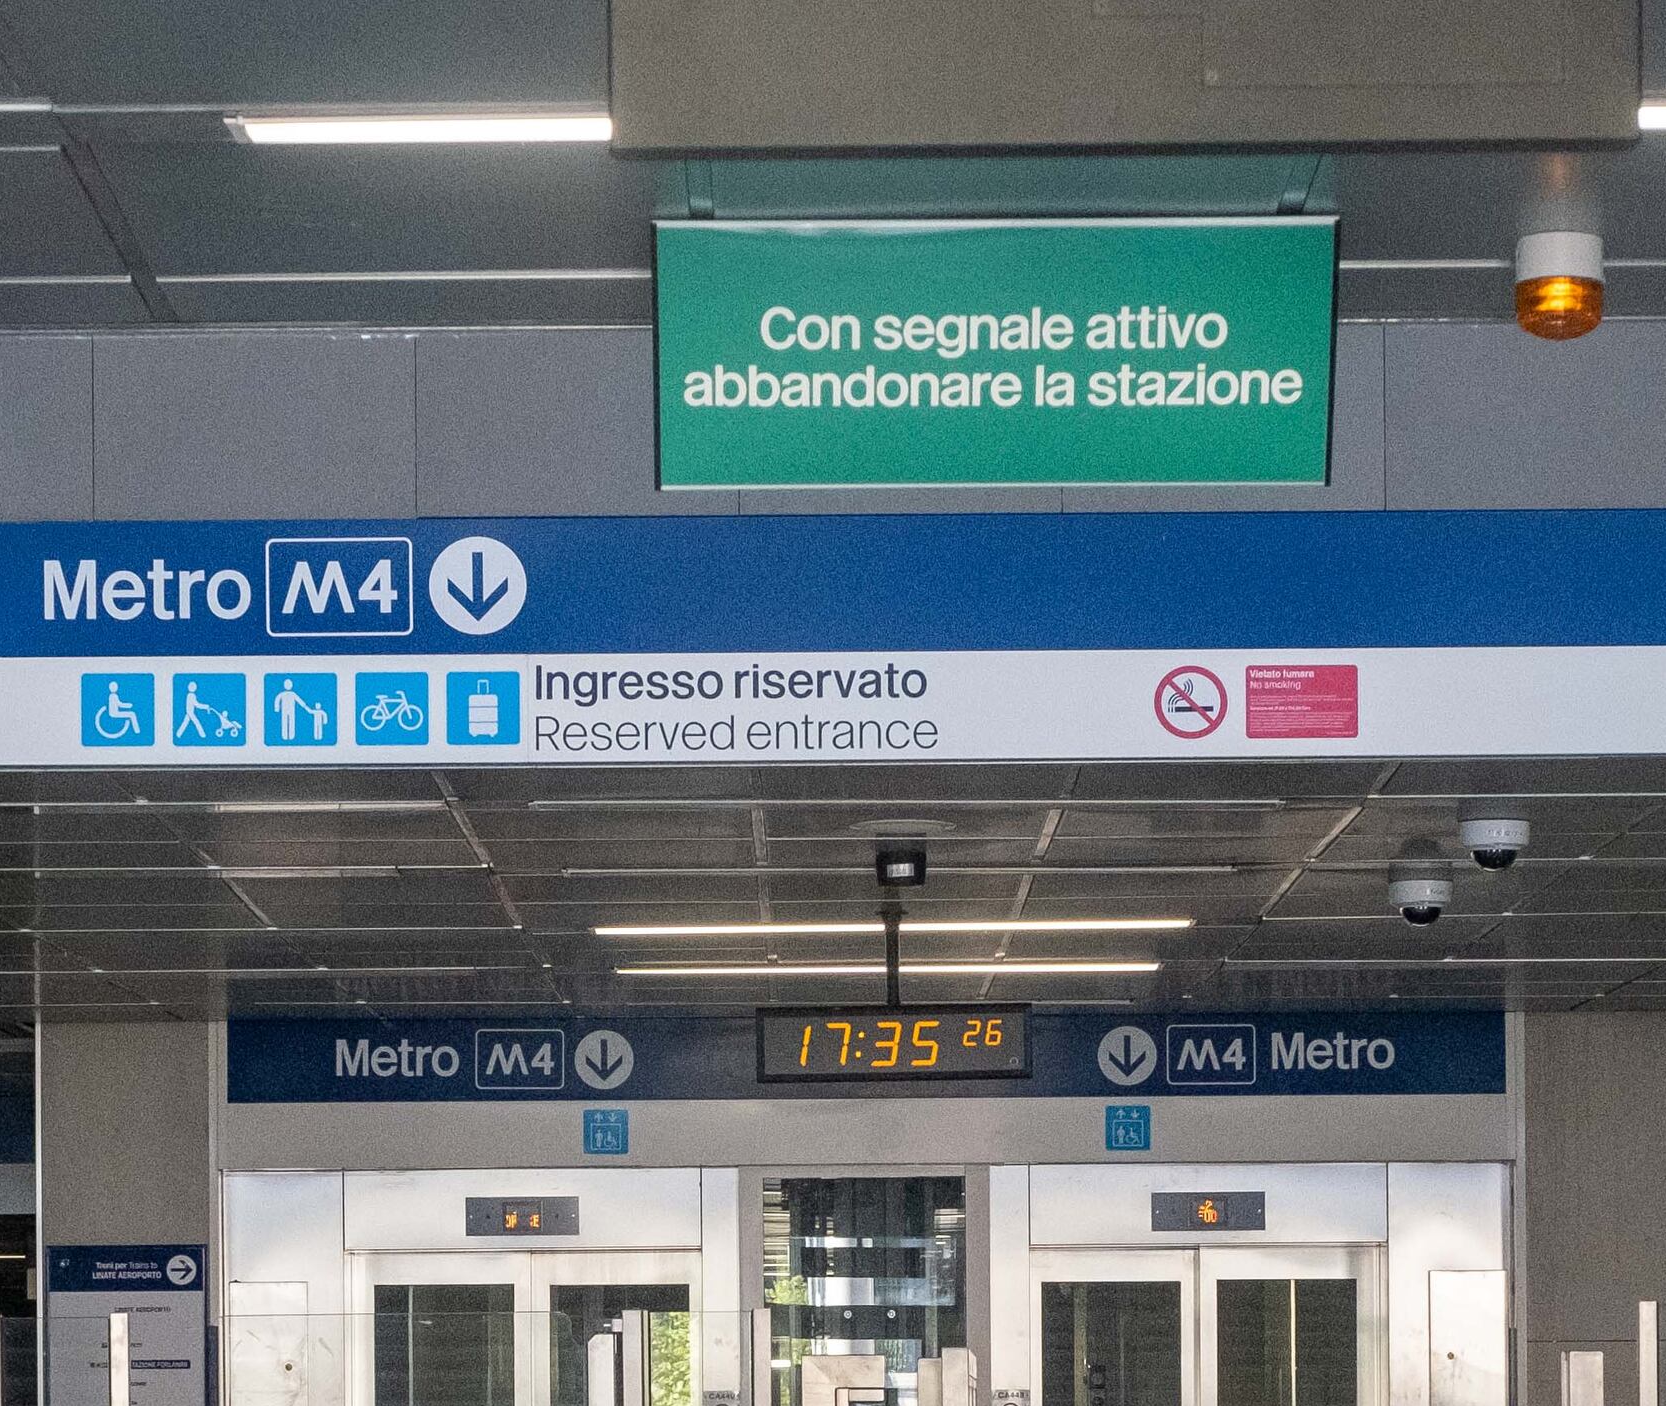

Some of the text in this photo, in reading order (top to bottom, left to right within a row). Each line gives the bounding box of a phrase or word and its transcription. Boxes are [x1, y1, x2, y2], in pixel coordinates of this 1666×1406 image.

[760, 305, 1229, 360] Con segnale attivo
[683, 362, 1303, 408] abbandonare la stazione
[43, 558, 398, 621] Metro M4
[535, 662, 928, 708] Ingresso riservato
[1249, 669, 1315, 679] Vietato fumare
[1249, 680, 1301, 691] No smoking
[535, 714, 939, 752] Reserved entrance
[335, 1038, 555, 1078] Metro M4
[798, 1019, 1003, 1068] 17:35 26
[1176, 1031, 1396, 1071] M4 Metro
[92, 1271, 162, 1280] LINATE AEROPORTO
